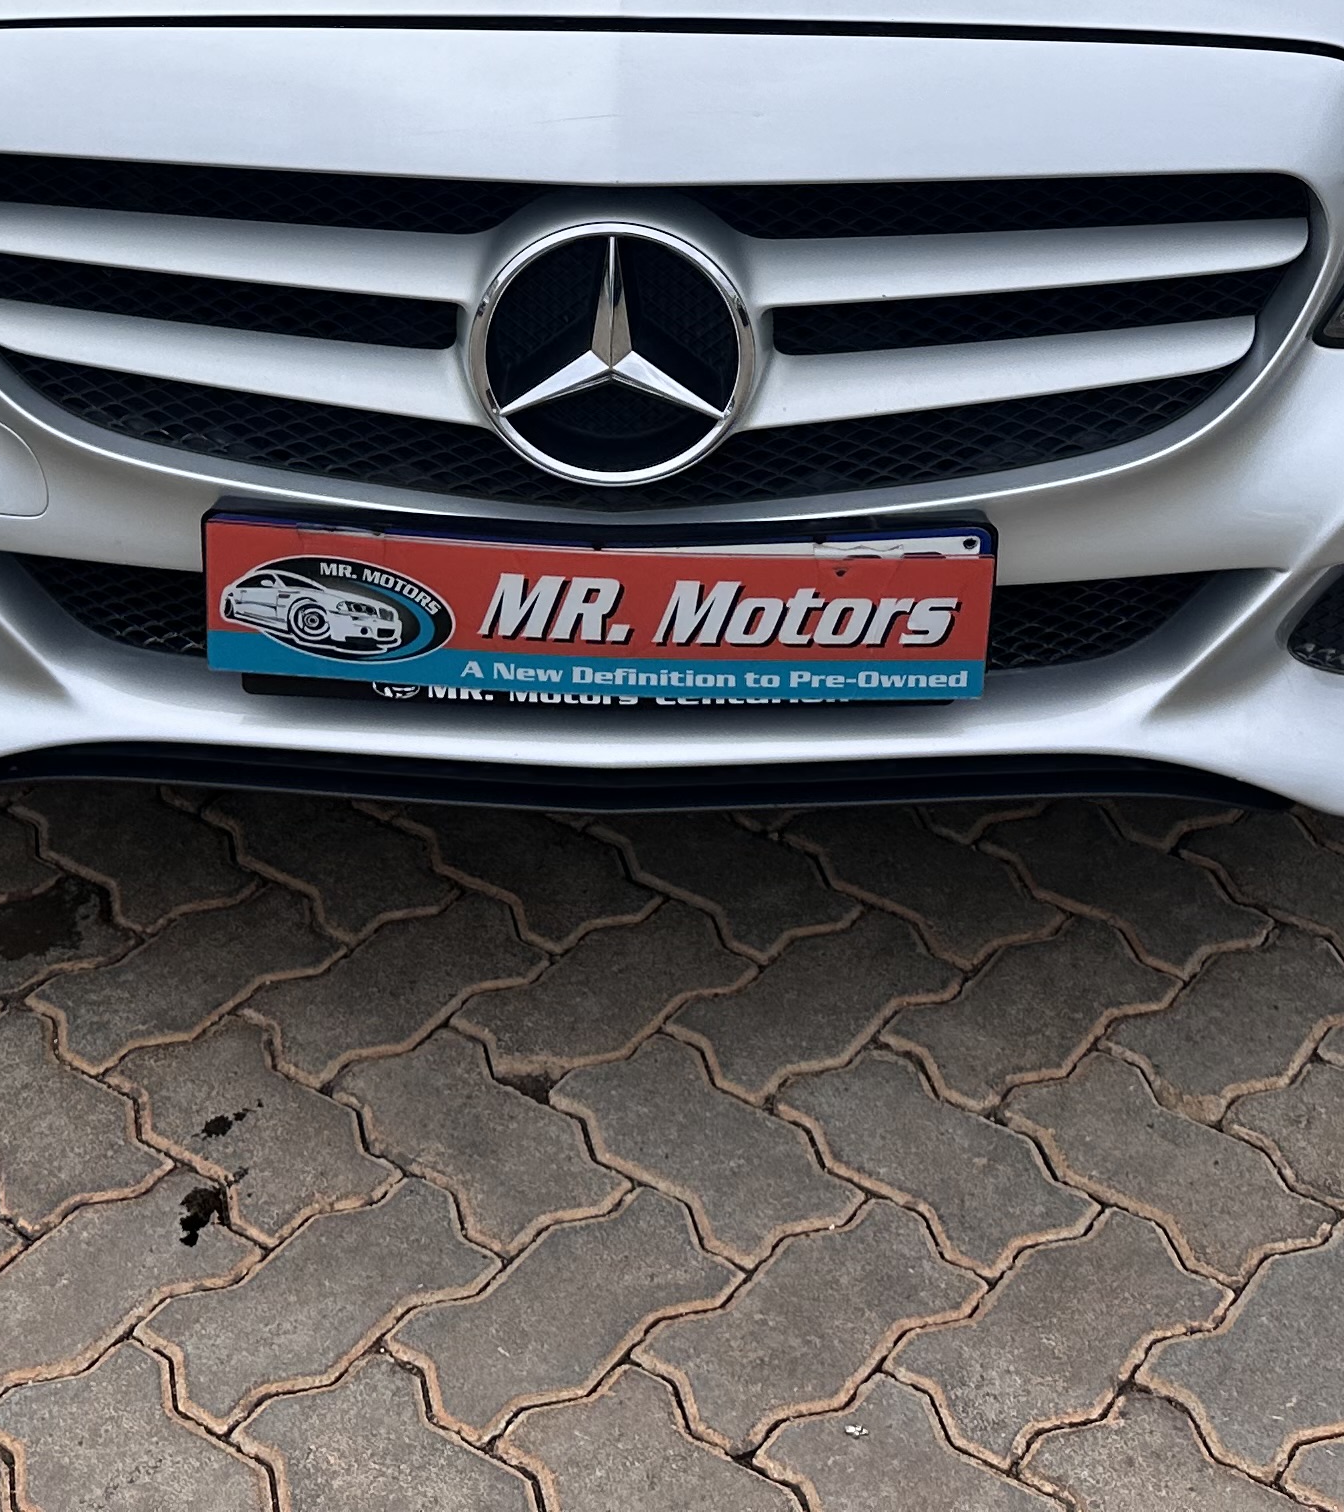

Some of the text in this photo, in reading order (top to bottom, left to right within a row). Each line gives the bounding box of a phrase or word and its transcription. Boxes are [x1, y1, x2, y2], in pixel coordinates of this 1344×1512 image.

[319, 561, 442, 616] MR. MOTORS
[477, 572, 959, 647] MR. Motors
[460, 660, 968, 690] A New Definition to Pre-Owned
